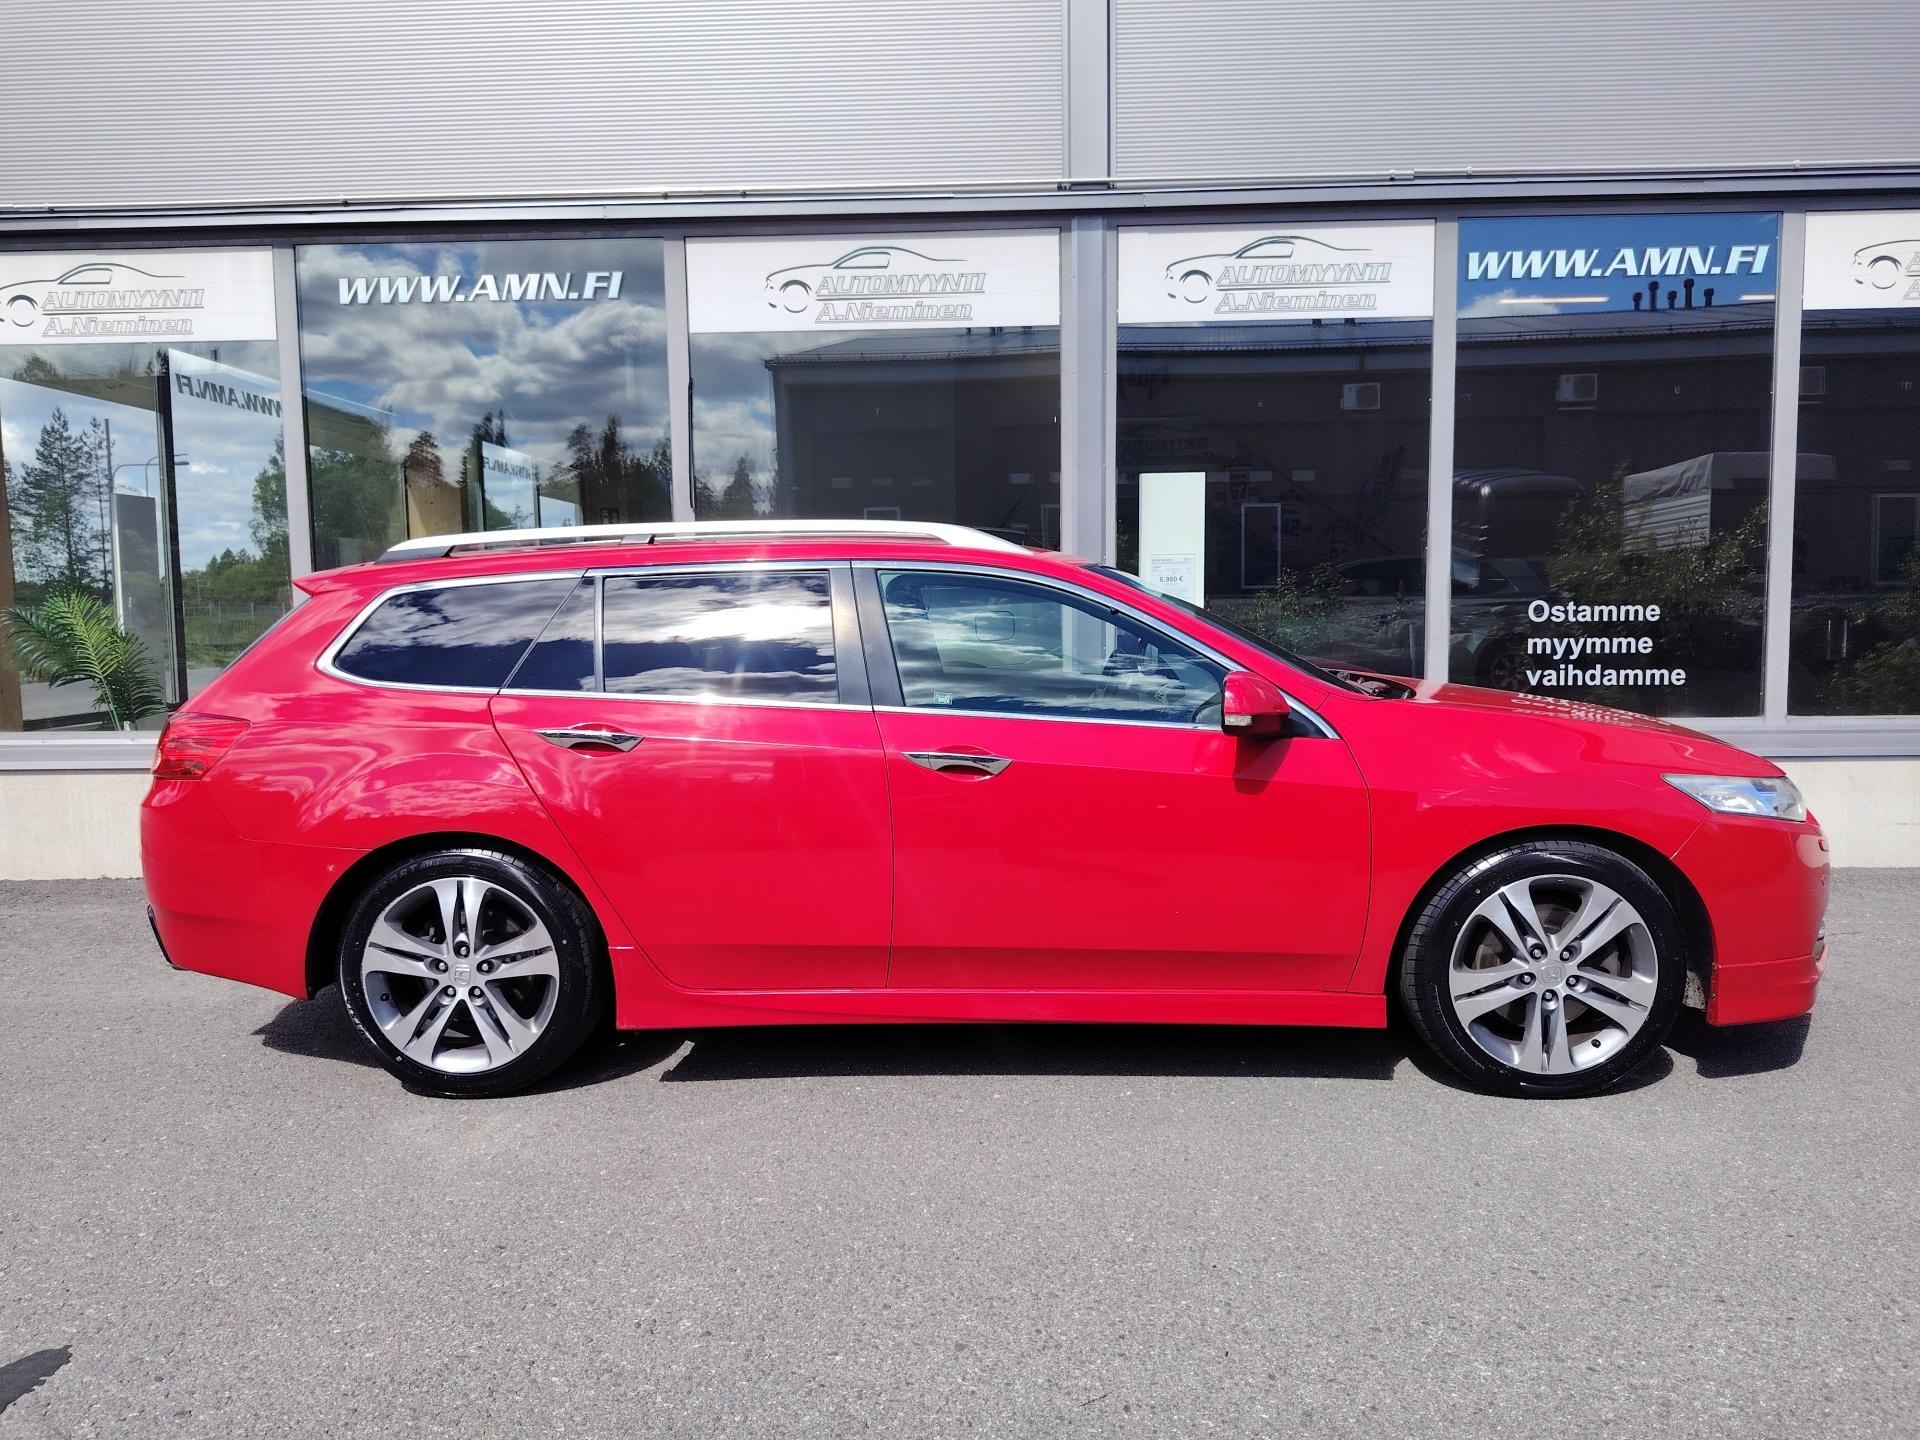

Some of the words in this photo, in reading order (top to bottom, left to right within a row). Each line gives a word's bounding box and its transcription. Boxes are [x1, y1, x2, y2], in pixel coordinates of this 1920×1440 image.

[1215, 262, 1393, 285] AUTOMYYNTI
[1467, 244, 1771, 280] WWW.AMN.FI
[337, 271, 624, 305] WWW.AMN.FI
[815, 272, 987, 295] AUTOMYYNTI
[41, 288, 206, 310] AUTOMYYNTI
[1215, 290, 1378, 312] A.Nieminen
[815, 300, 974, 322] A.Nieminen
[42, 315, 195, 336] A.Nieminen
[1527, 599, 1661, 623] Ostamme
[1527, 636, 1654, 660] myymme
[1525, 663, 1687, 686] vaihdamme
